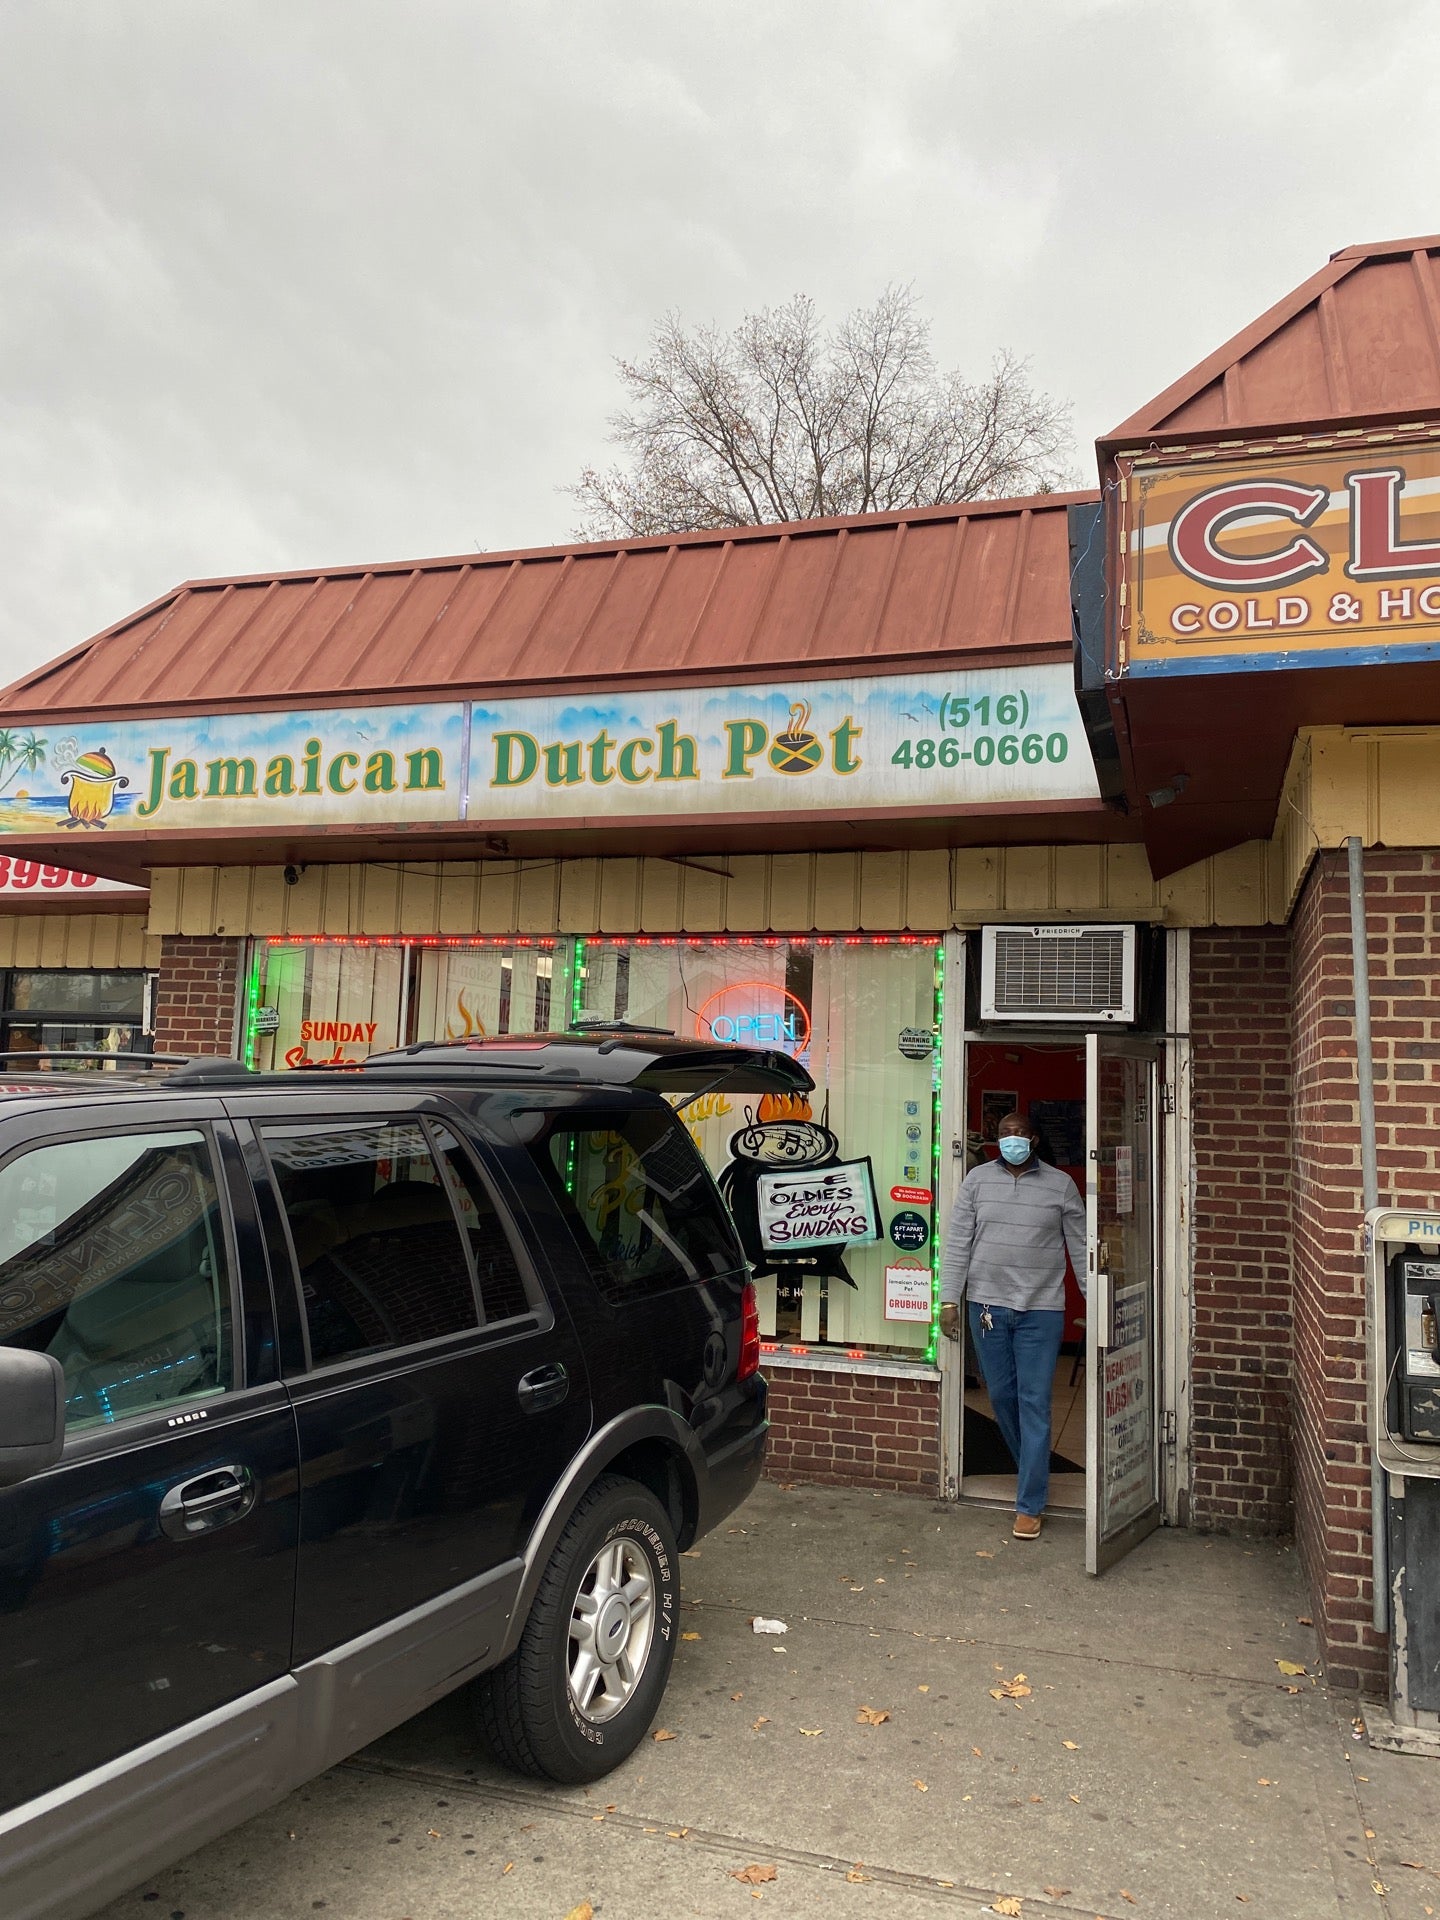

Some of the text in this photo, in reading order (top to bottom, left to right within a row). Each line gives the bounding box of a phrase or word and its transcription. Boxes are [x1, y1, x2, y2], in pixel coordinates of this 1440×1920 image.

[1170, 595, 1310, 634] COLD
[1328, 591, 1364, 624] &
[938, 690, 1030, 731] (516)
[891, 731, 1069, 770] 486-0660
[136, 736, 446, 818] Jamaican
[489, 717, 701, 788] Dutch
[301, 1021, 378, 1042] SUNDAY
[711, 1013, 795, 1042] OPEN
[901, 1036, 930, 1044] WARNING
[770, 1187, 853, 1206] OLDIES
[785, 1202, 855, 1220] Every
[769, 1216, 868, 1241] SUNDAYS
[889, 1299, 928, 1310] GRUBHUB
[1110, 1419, 1128, 1437] TAKE
[661, 1593, 672, 1641] H/T
